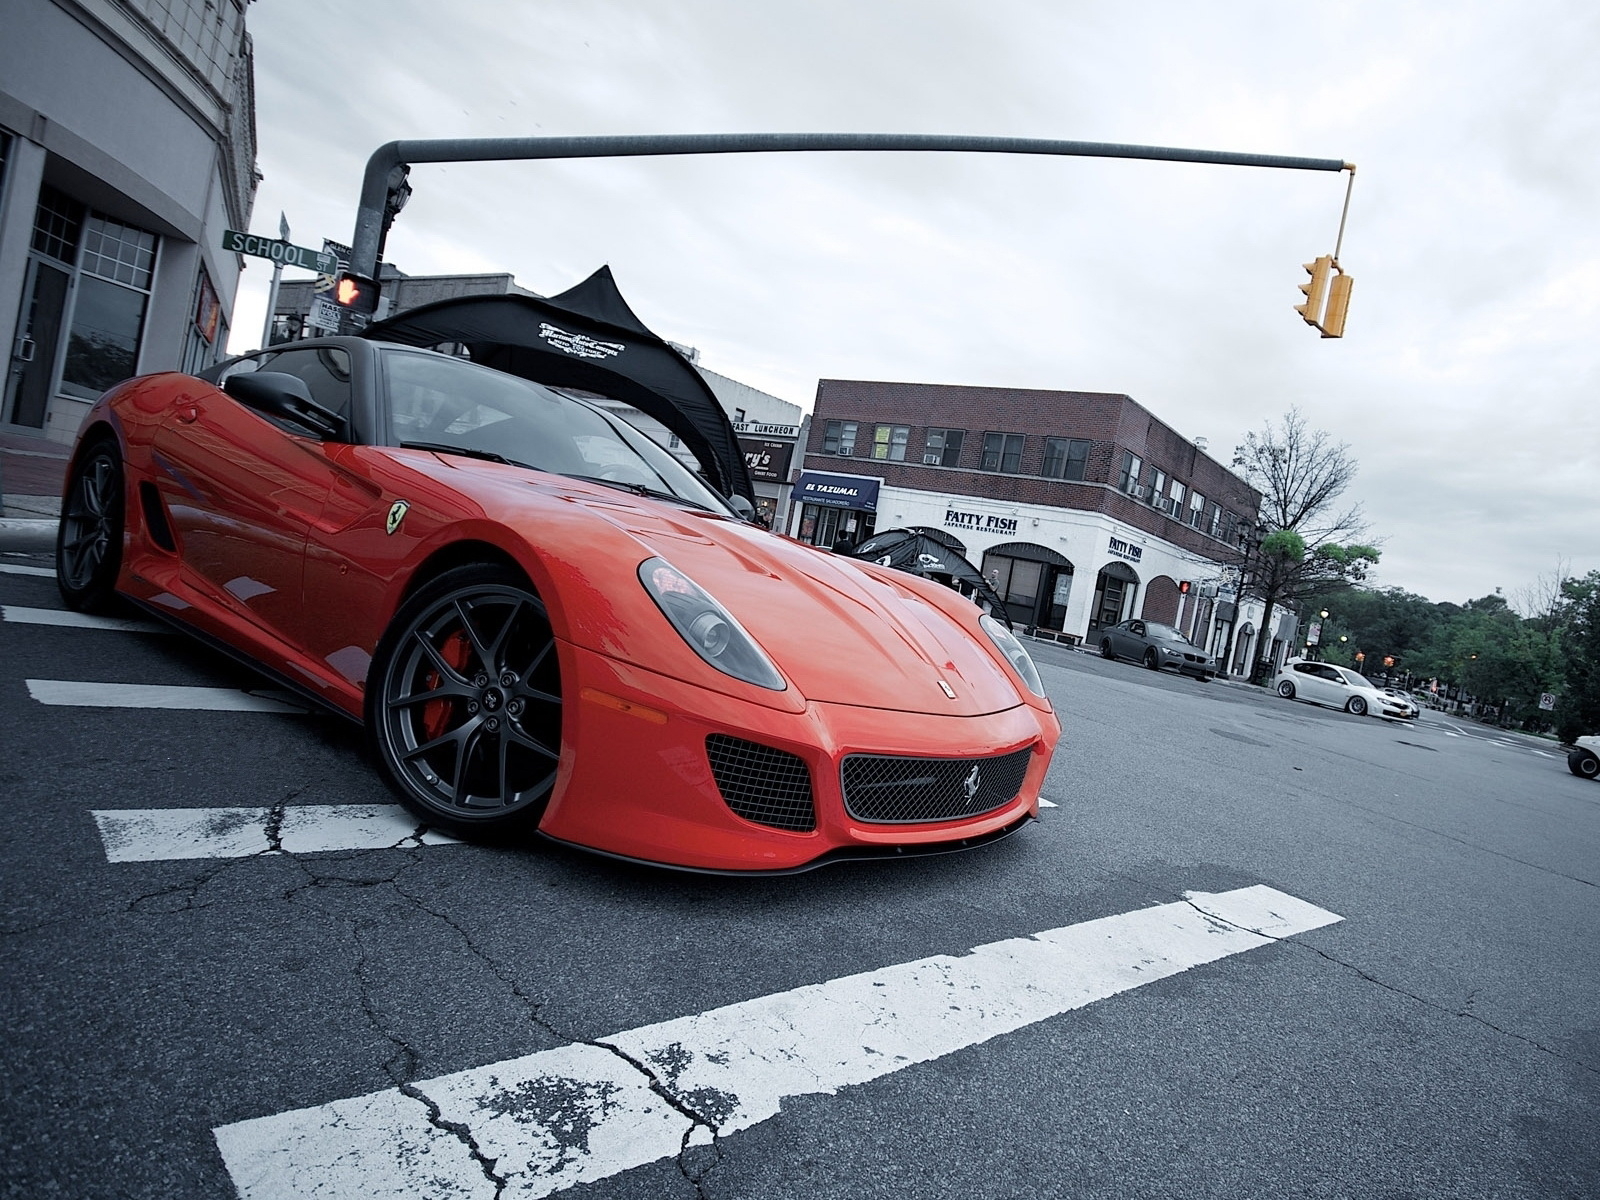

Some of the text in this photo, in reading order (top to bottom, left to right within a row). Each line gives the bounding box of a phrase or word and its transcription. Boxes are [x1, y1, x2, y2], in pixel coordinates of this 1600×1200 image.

[231, 233, 328, 272] SCHOOL ST
[732, 423, 794, 435] FAST LUNCHEON
[743, 450, 771, 468] ry's
[805, 483, 858, 497] EL TAZUMAL
[944, 522, 1017, 537] JAPANESE RESTAURANT
[945, 510, 1018, 531] FATTY FISH
[1109, 536, 1143, 559] FATTY FISH
